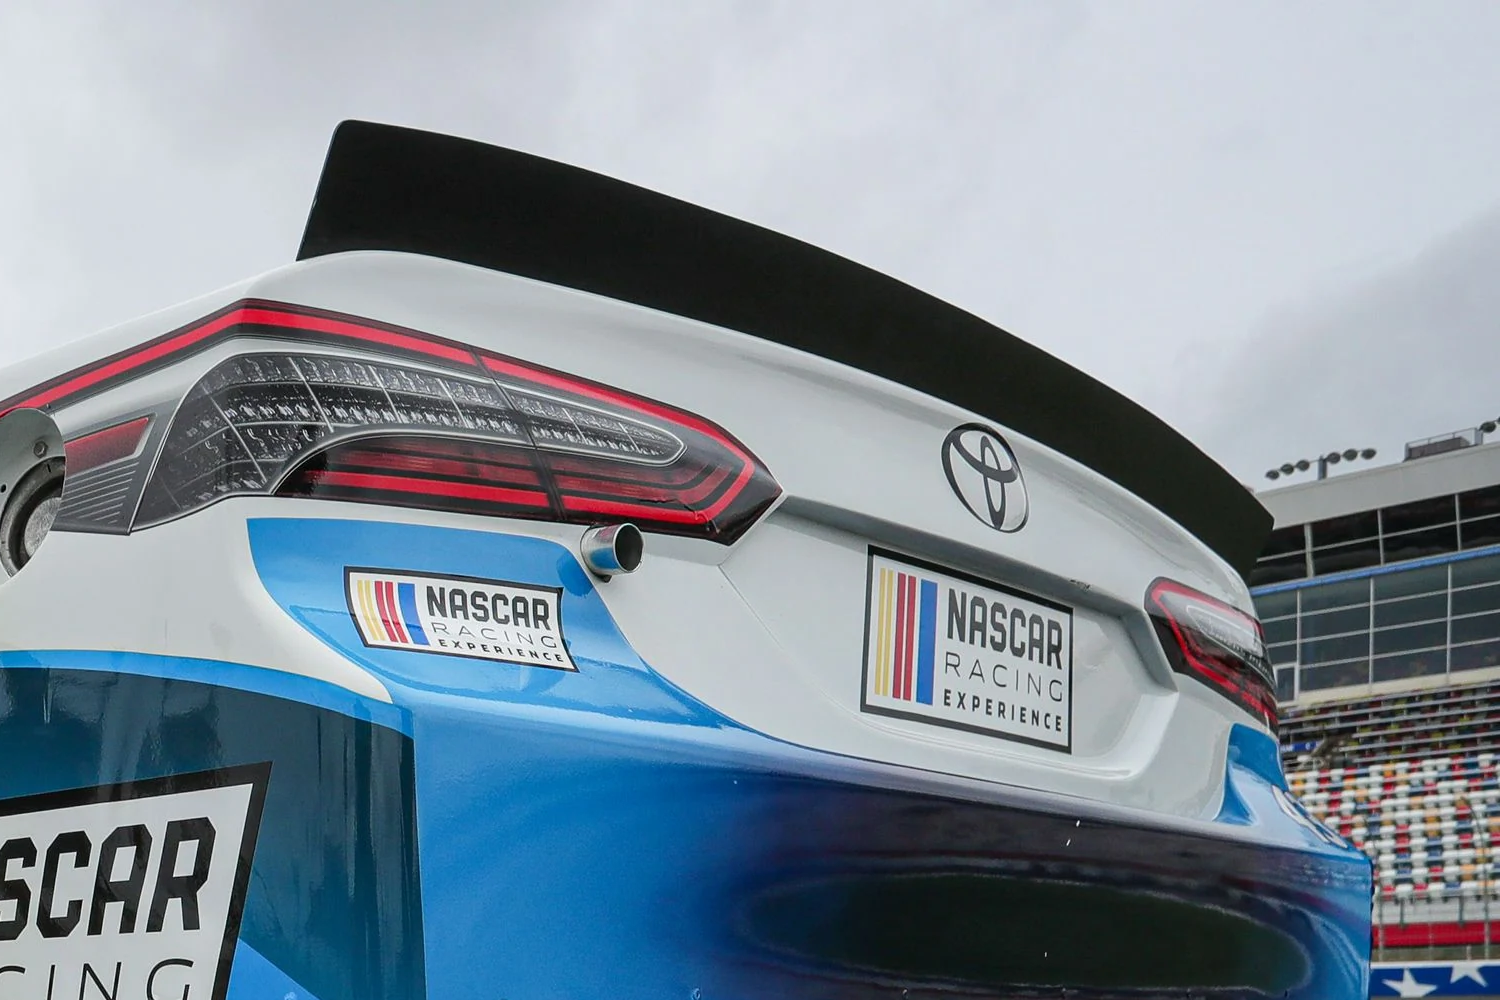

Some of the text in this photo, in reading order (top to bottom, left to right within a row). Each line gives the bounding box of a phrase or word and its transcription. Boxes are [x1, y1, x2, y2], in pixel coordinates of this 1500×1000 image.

[426, 585, 551, 631] NASCAR
[946, 587, 1063, 670] NASCAR
[432, 622, 558, 649] RACING
[438, 638, 564, 663] EXPERIENCE
[944, 651, 1063, 702] RACING
[943, 688, 1062, 732] EXPERIENCE
